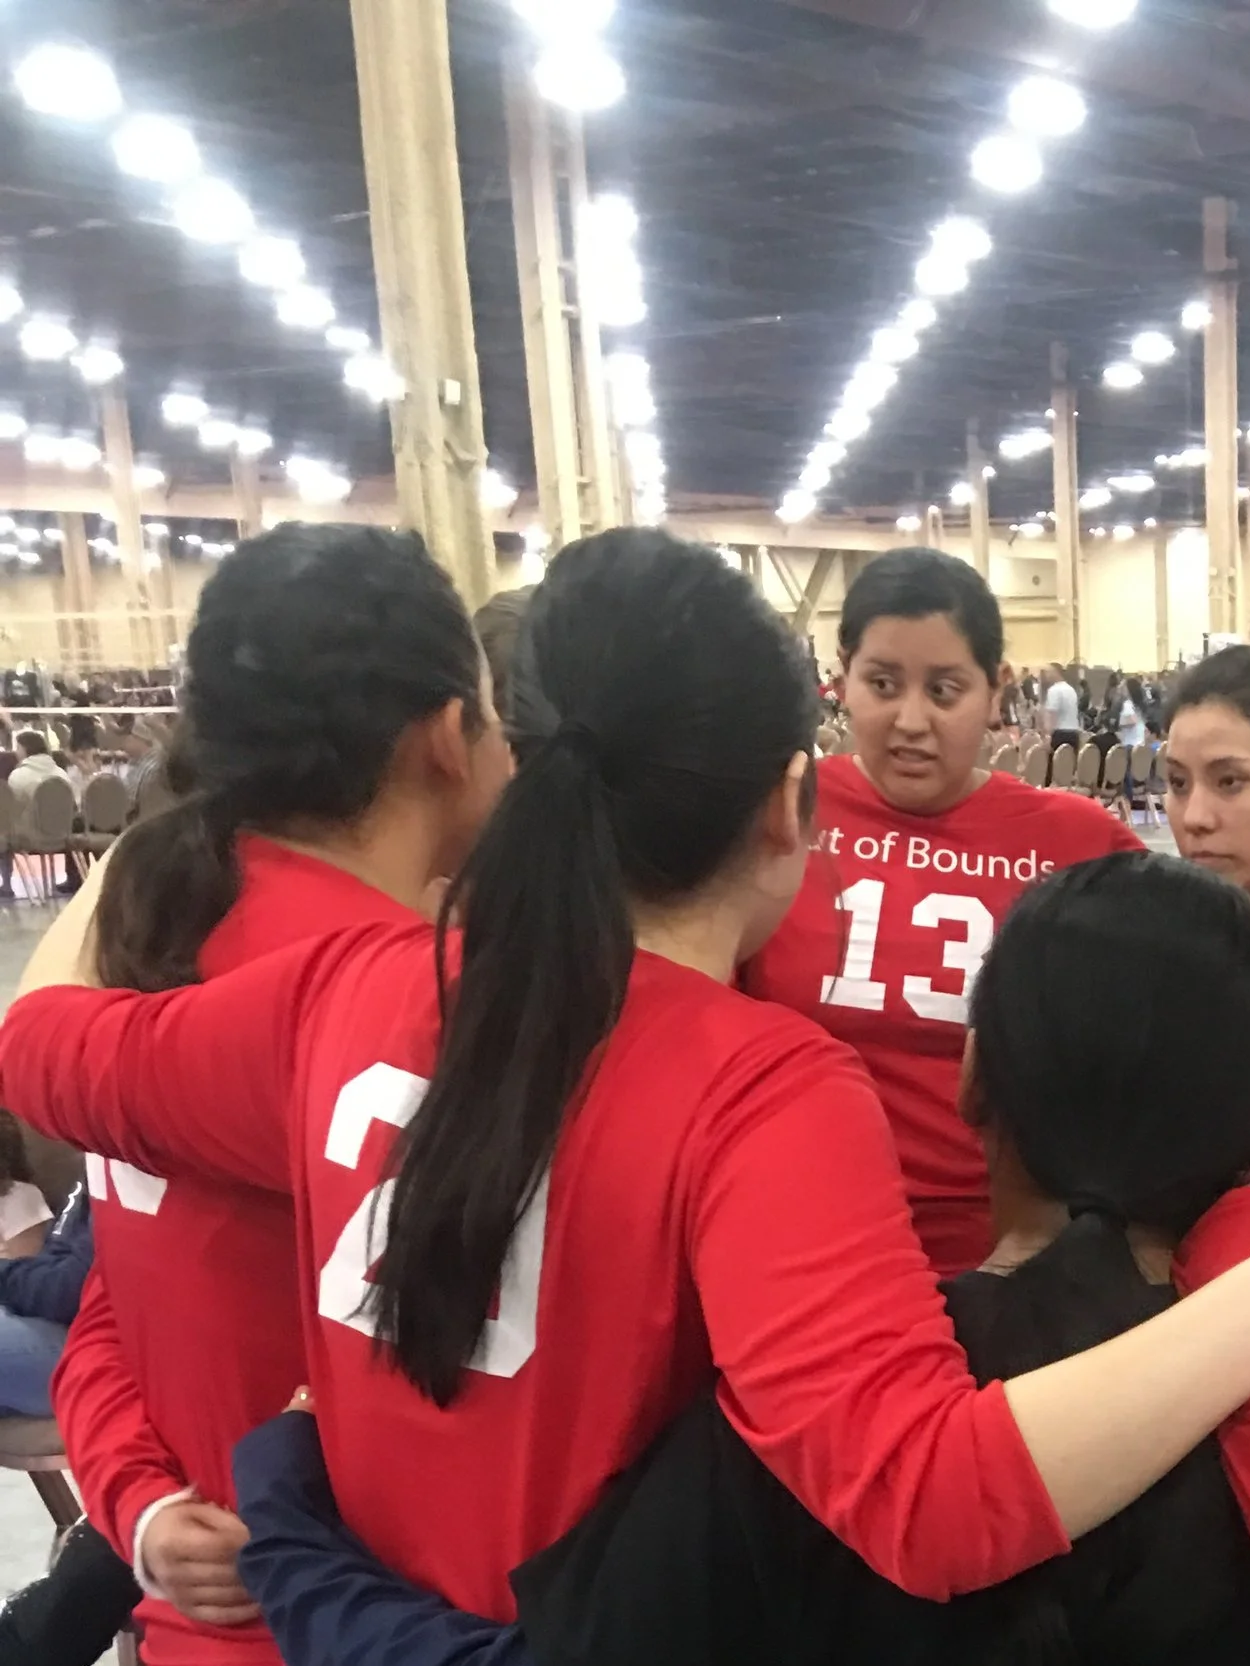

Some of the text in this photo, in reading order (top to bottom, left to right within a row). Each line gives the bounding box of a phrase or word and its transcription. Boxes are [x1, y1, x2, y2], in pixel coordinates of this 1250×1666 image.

[854, 831, 899, 863] of
[906, 836, 1055, 882] Bounds
[820, 878, 994, 1024] 13
